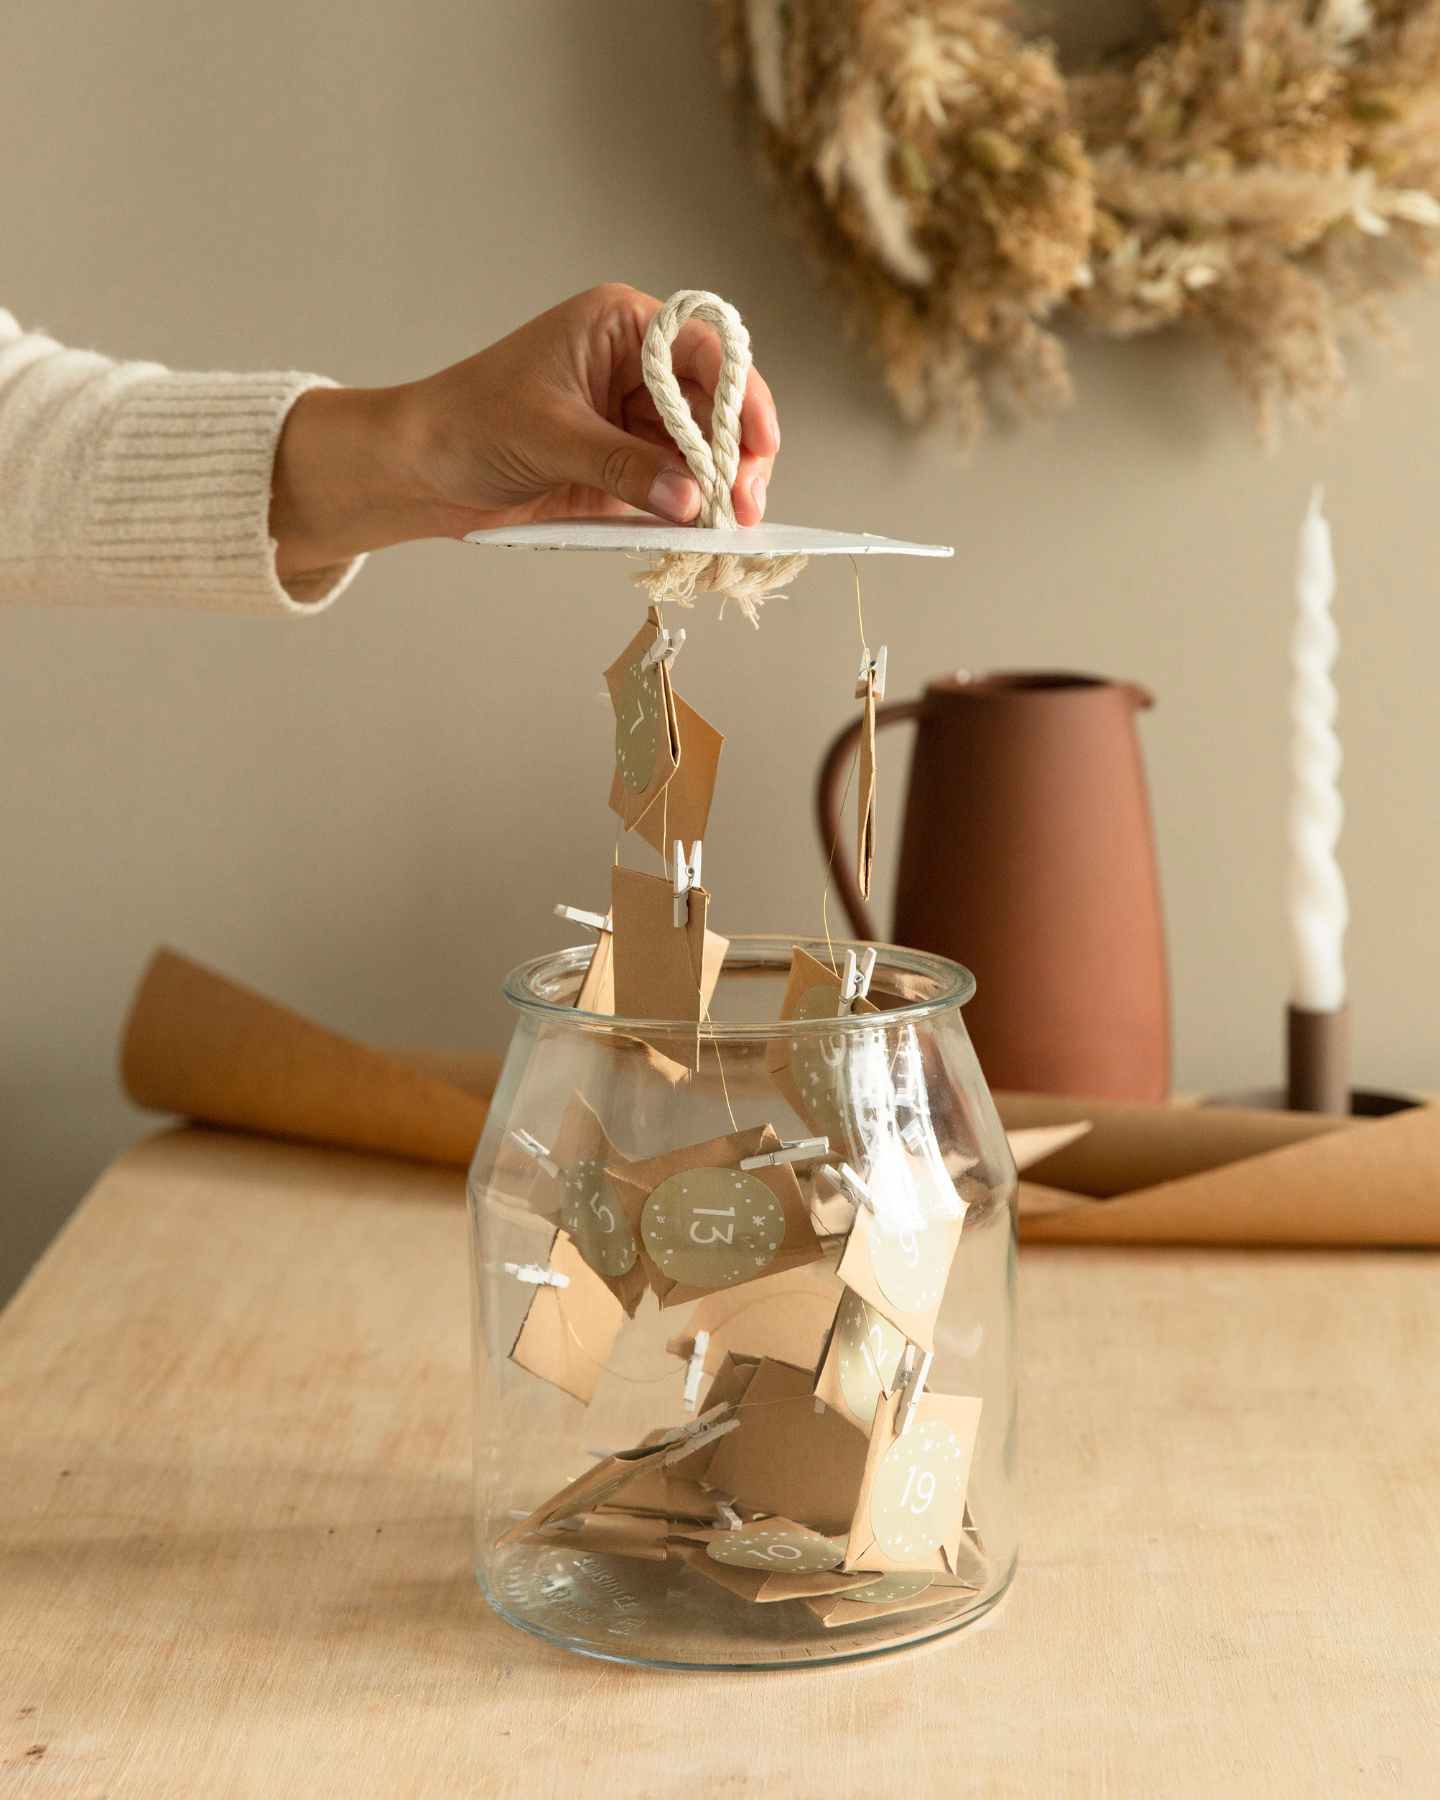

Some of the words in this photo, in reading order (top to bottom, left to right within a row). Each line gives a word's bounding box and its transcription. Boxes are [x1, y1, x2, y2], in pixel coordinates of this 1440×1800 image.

[590, 1191, 615, 1233] 5
[689, 1206, 736, 1245] 13
[900, 1465, 936, 1514] 19
[748, 1543, 802, 1561] 10
